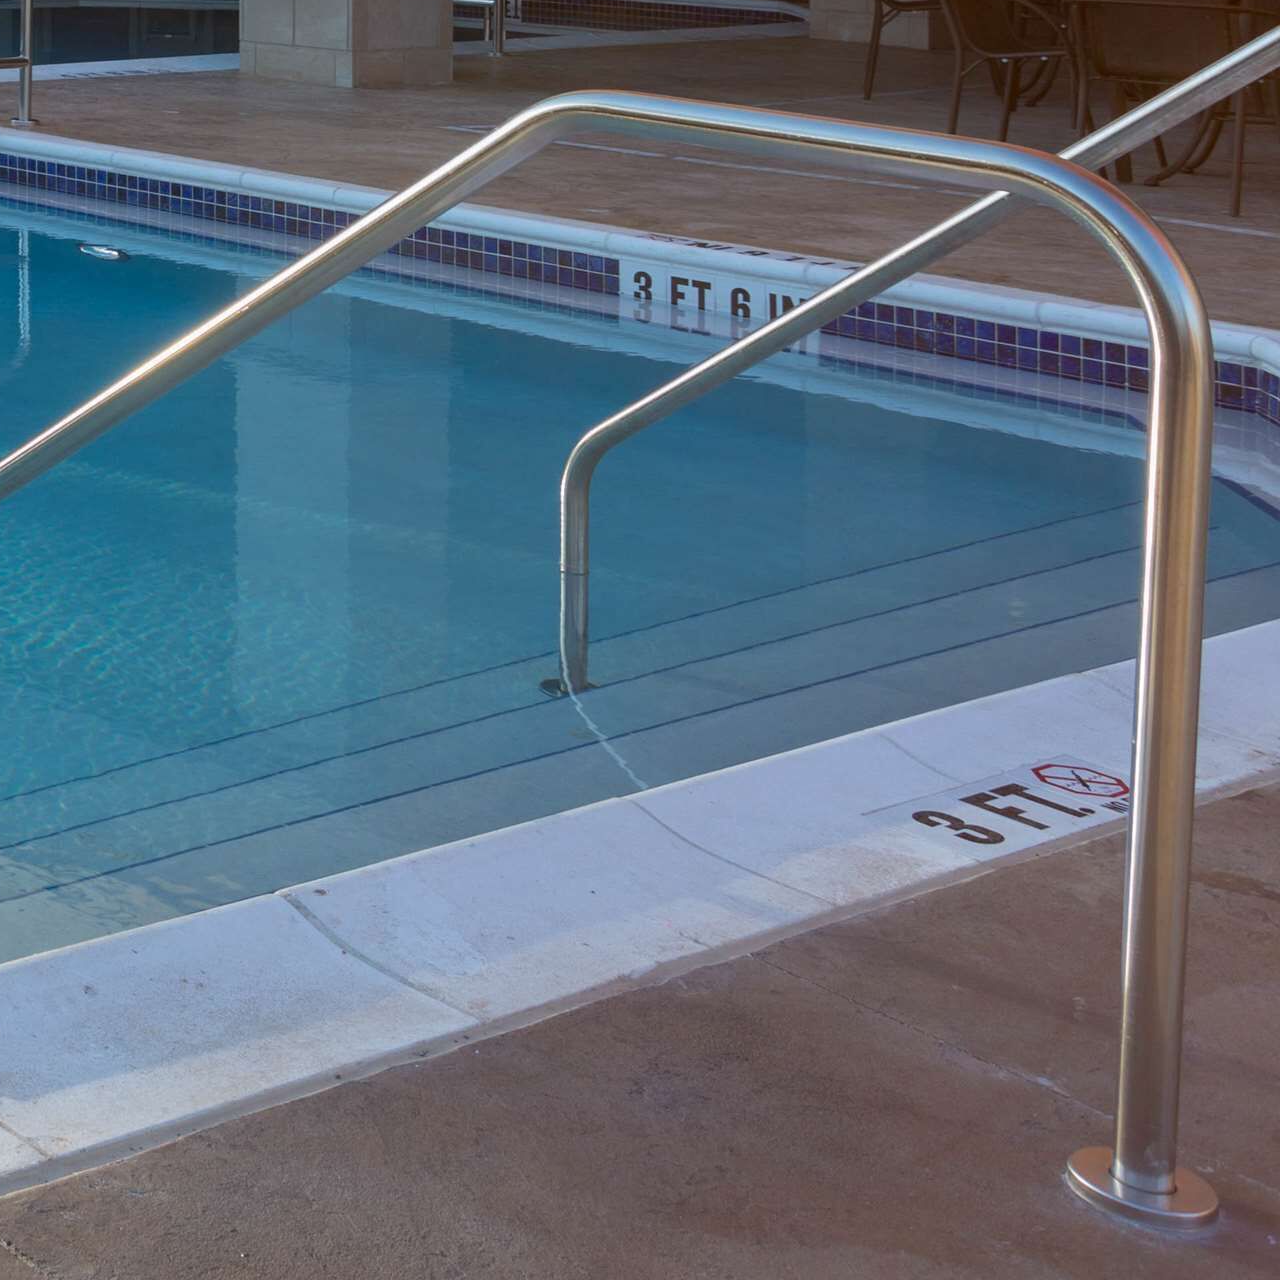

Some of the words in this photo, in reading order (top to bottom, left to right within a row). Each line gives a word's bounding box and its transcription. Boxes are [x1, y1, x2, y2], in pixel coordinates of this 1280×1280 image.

[633, 271, 653, 301] 3
[670, 276, 712, 311] FT
[730, 287, 752, 318] 6
[912, 810, 1005, 845] 3
[958, 783, 1096, 830] FT.
